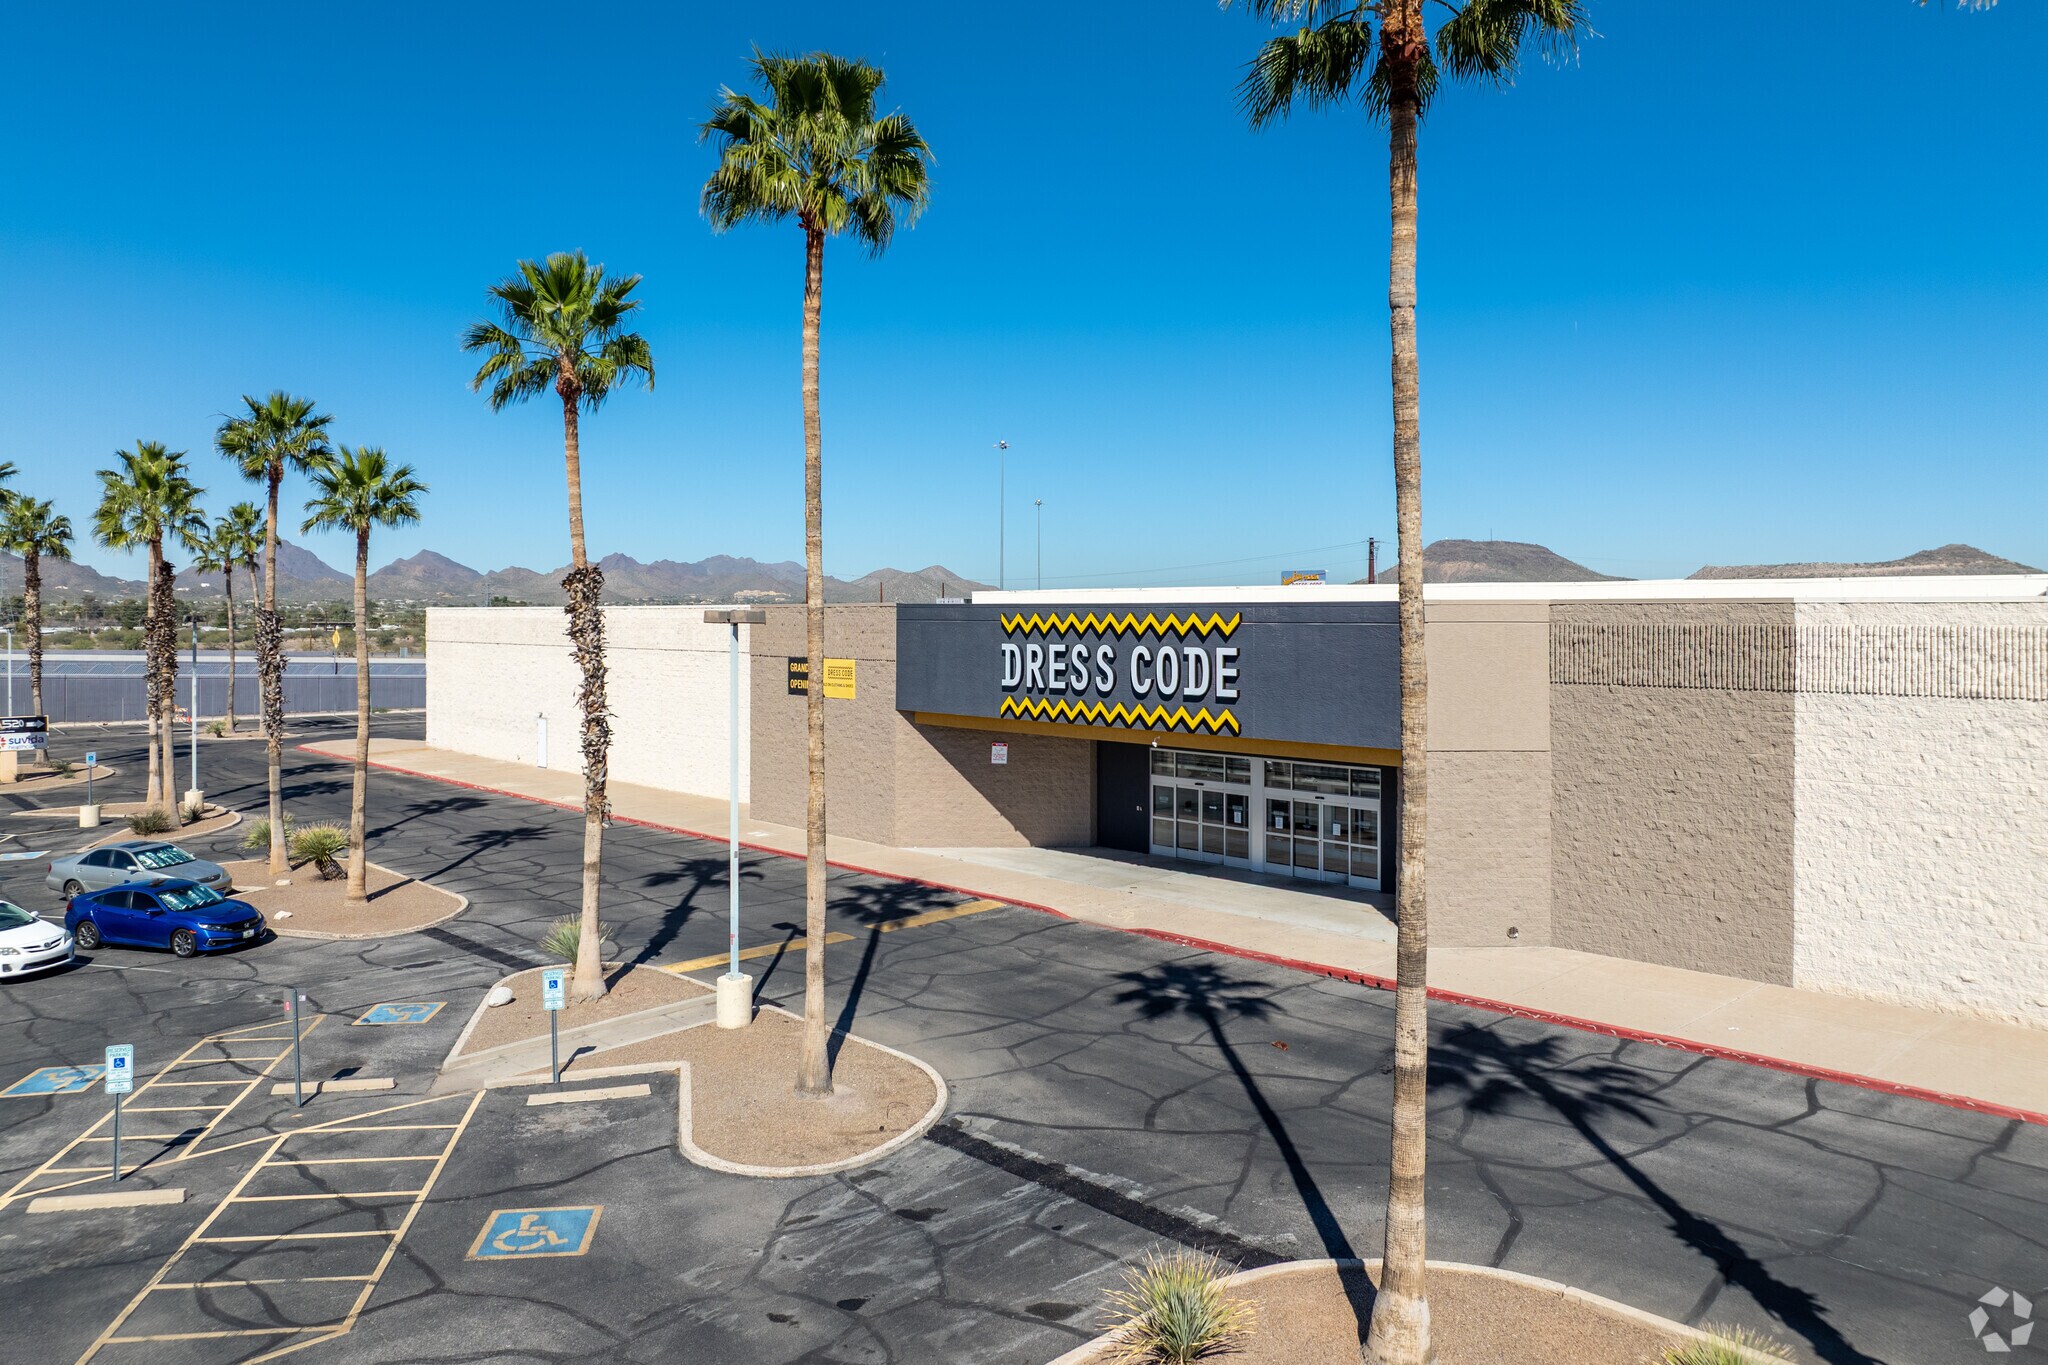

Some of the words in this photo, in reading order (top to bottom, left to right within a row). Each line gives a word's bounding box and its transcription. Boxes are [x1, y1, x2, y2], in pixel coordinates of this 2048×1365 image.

[828, 669, 841, 677] DRESS
[842, 669, 853, 678] CODE
[1001, 643, 1115, 692] DRESS
[1130, 645, 1238, 698] CODE
[789, 679, 808, 689] OPENI
[2, 719, 24, 728] 520
[8, 735, 44, 745] suvida
